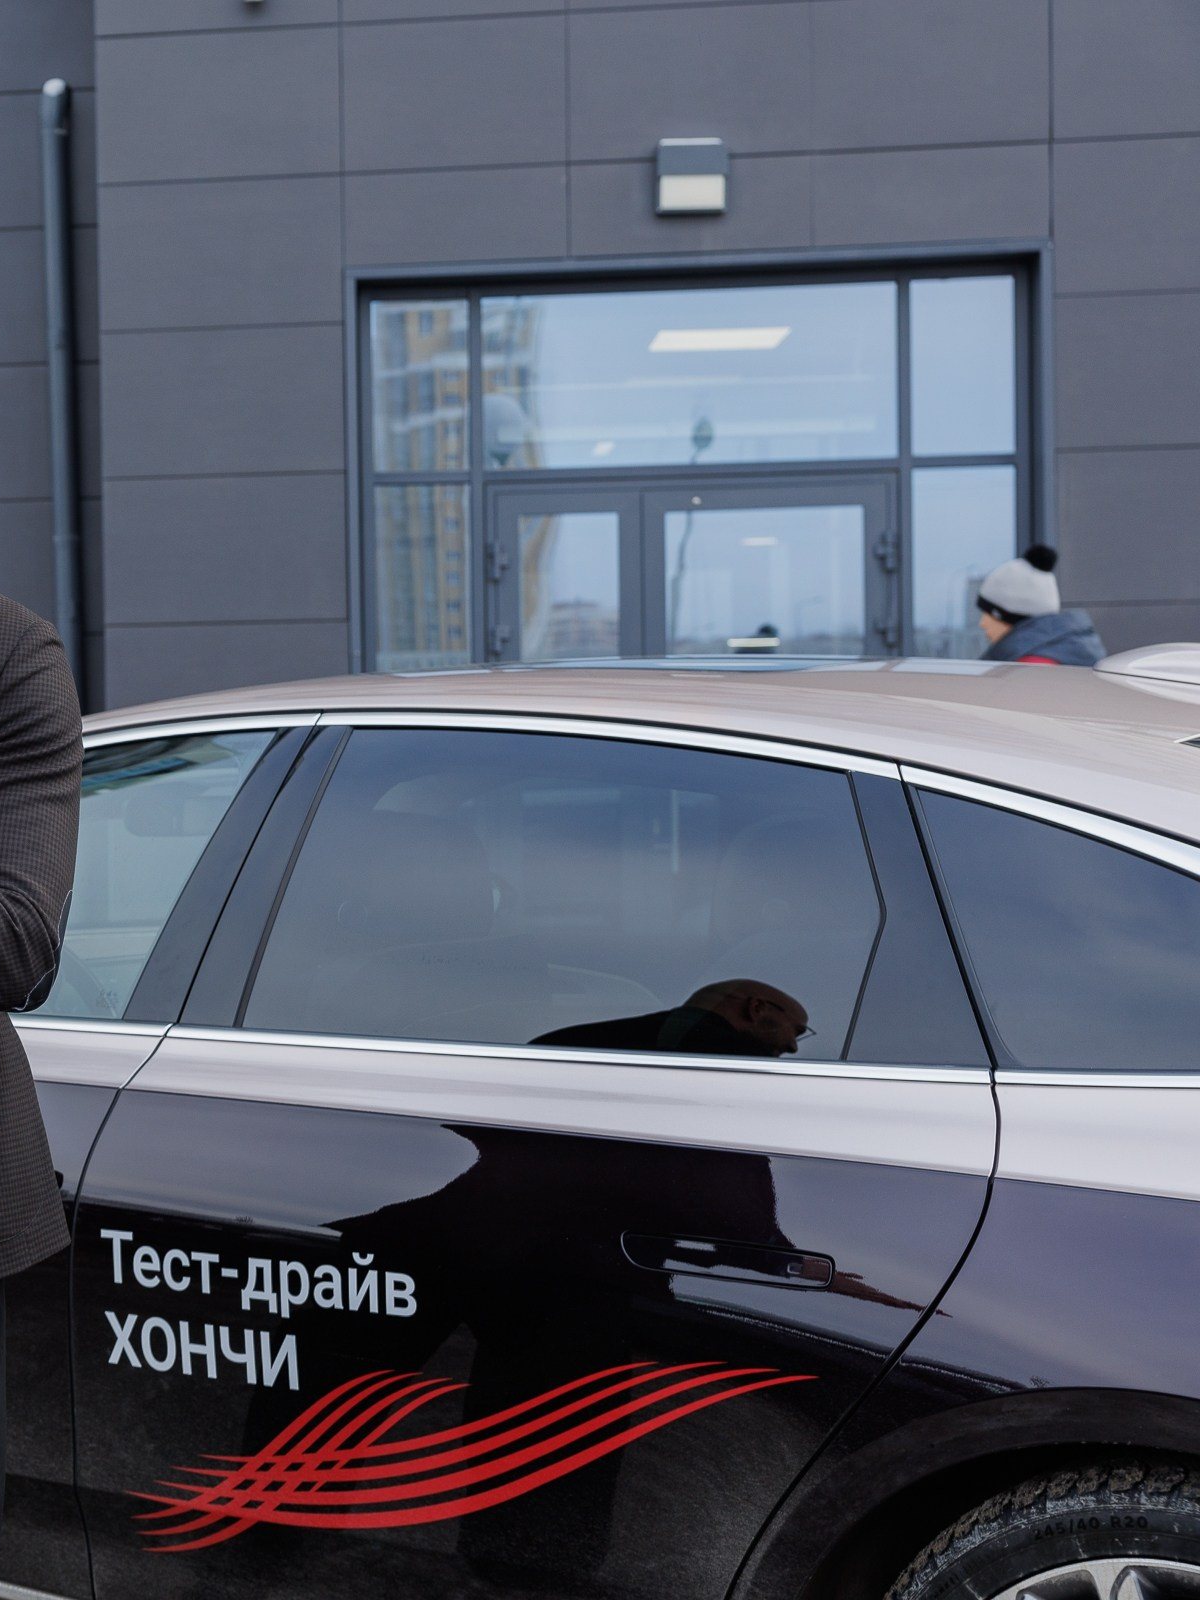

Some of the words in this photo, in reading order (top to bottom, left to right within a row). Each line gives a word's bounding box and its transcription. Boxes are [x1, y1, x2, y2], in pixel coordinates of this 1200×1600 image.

[100, 1228, 417, 1319] Тест-драйв
[104, 1310, 299, 1391] ХОНЧИ
[1033, 1516, 1100, 1541] 245/40
[1109, 1515, 1149, 1529] R20
